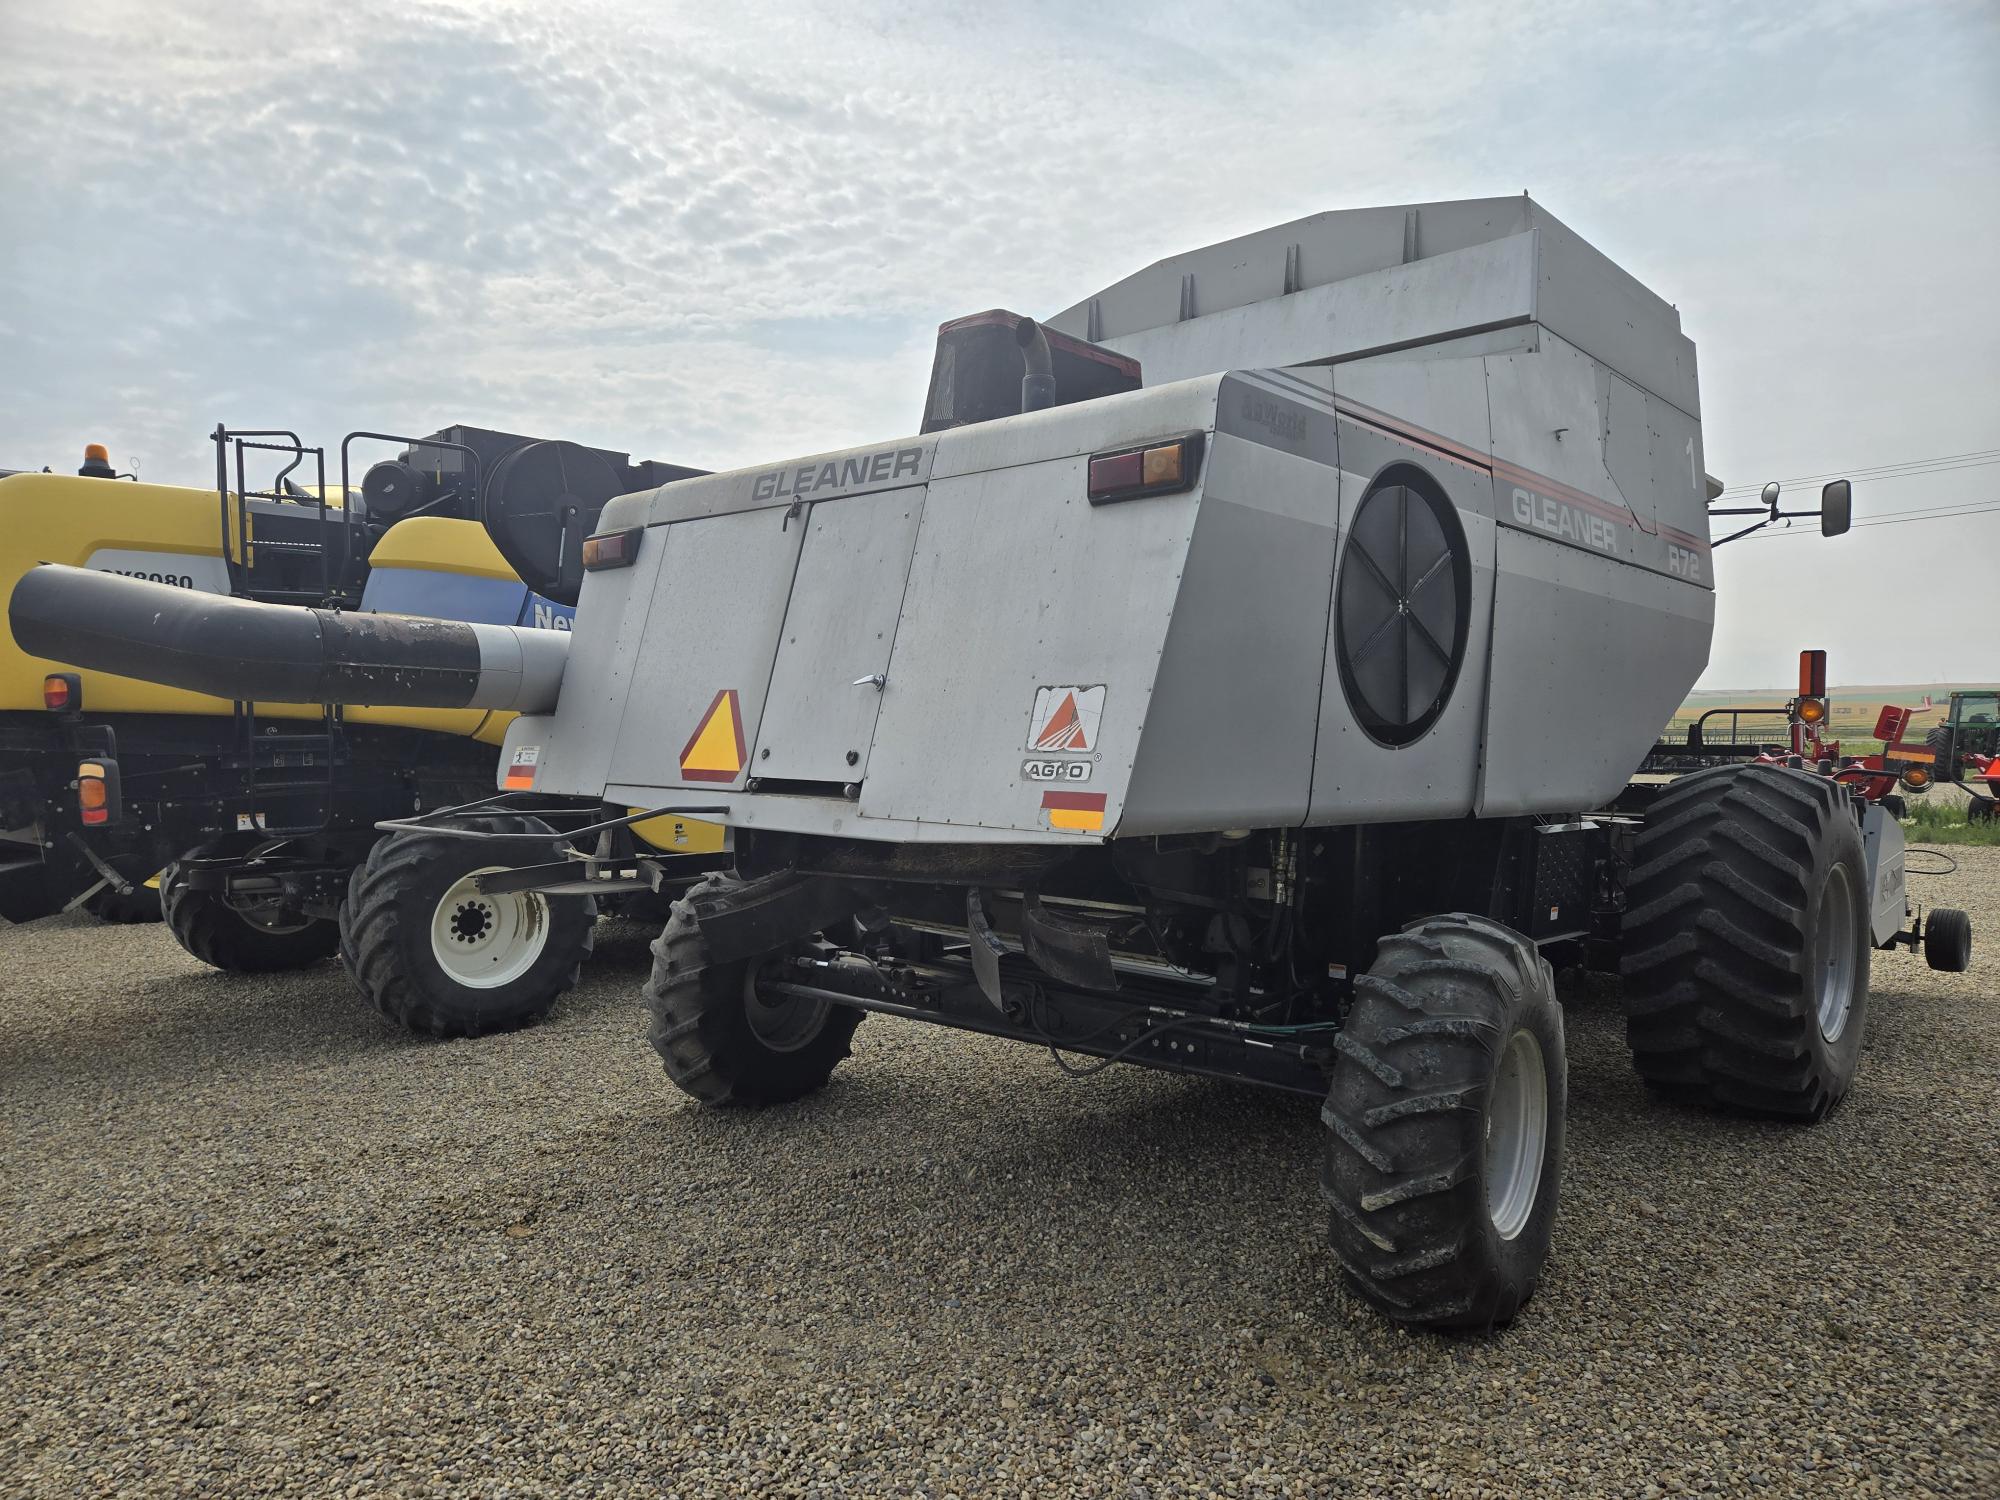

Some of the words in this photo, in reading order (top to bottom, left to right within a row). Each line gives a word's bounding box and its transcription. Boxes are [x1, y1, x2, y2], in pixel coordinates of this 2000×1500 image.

[752, 447, 923, 501] GLEANER
[1686, 437, 1696, 490] 1
[1512, 487, 1617, 553] GLEANER
[1668, 544, 1700, 580] R72
